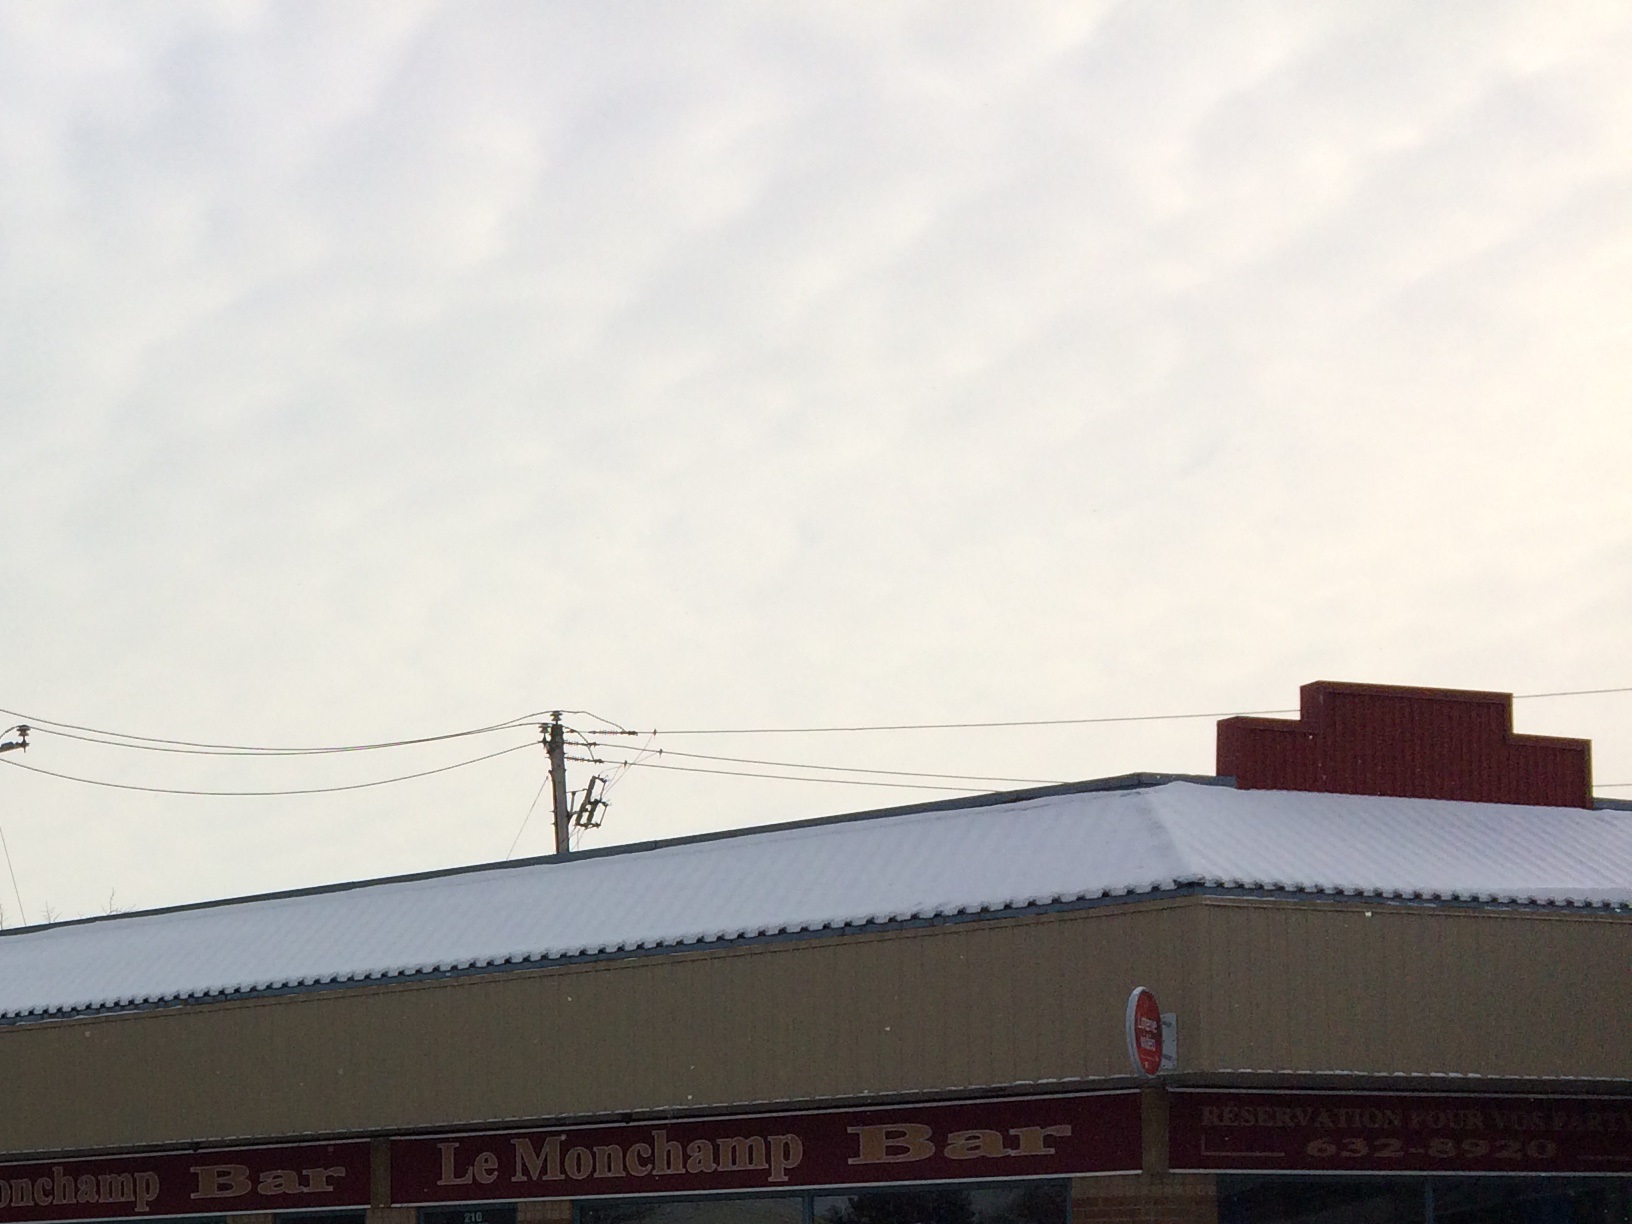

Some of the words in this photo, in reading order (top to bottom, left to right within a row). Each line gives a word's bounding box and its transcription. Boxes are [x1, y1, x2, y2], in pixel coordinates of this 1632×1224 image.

[1200, 1102, 1399, 1128] RÉSERVATION
[1409, 1108, 1484, 1130] POUR
[437, 1141, 499, 1185] Le
[511, 1130, 803, 1182] Monchamp
[846, 1123, 1072, 1165] Bar
[1305, 1137, 1557, 1159] 632-8920
[190, 1163, 346, 1200] Bar
